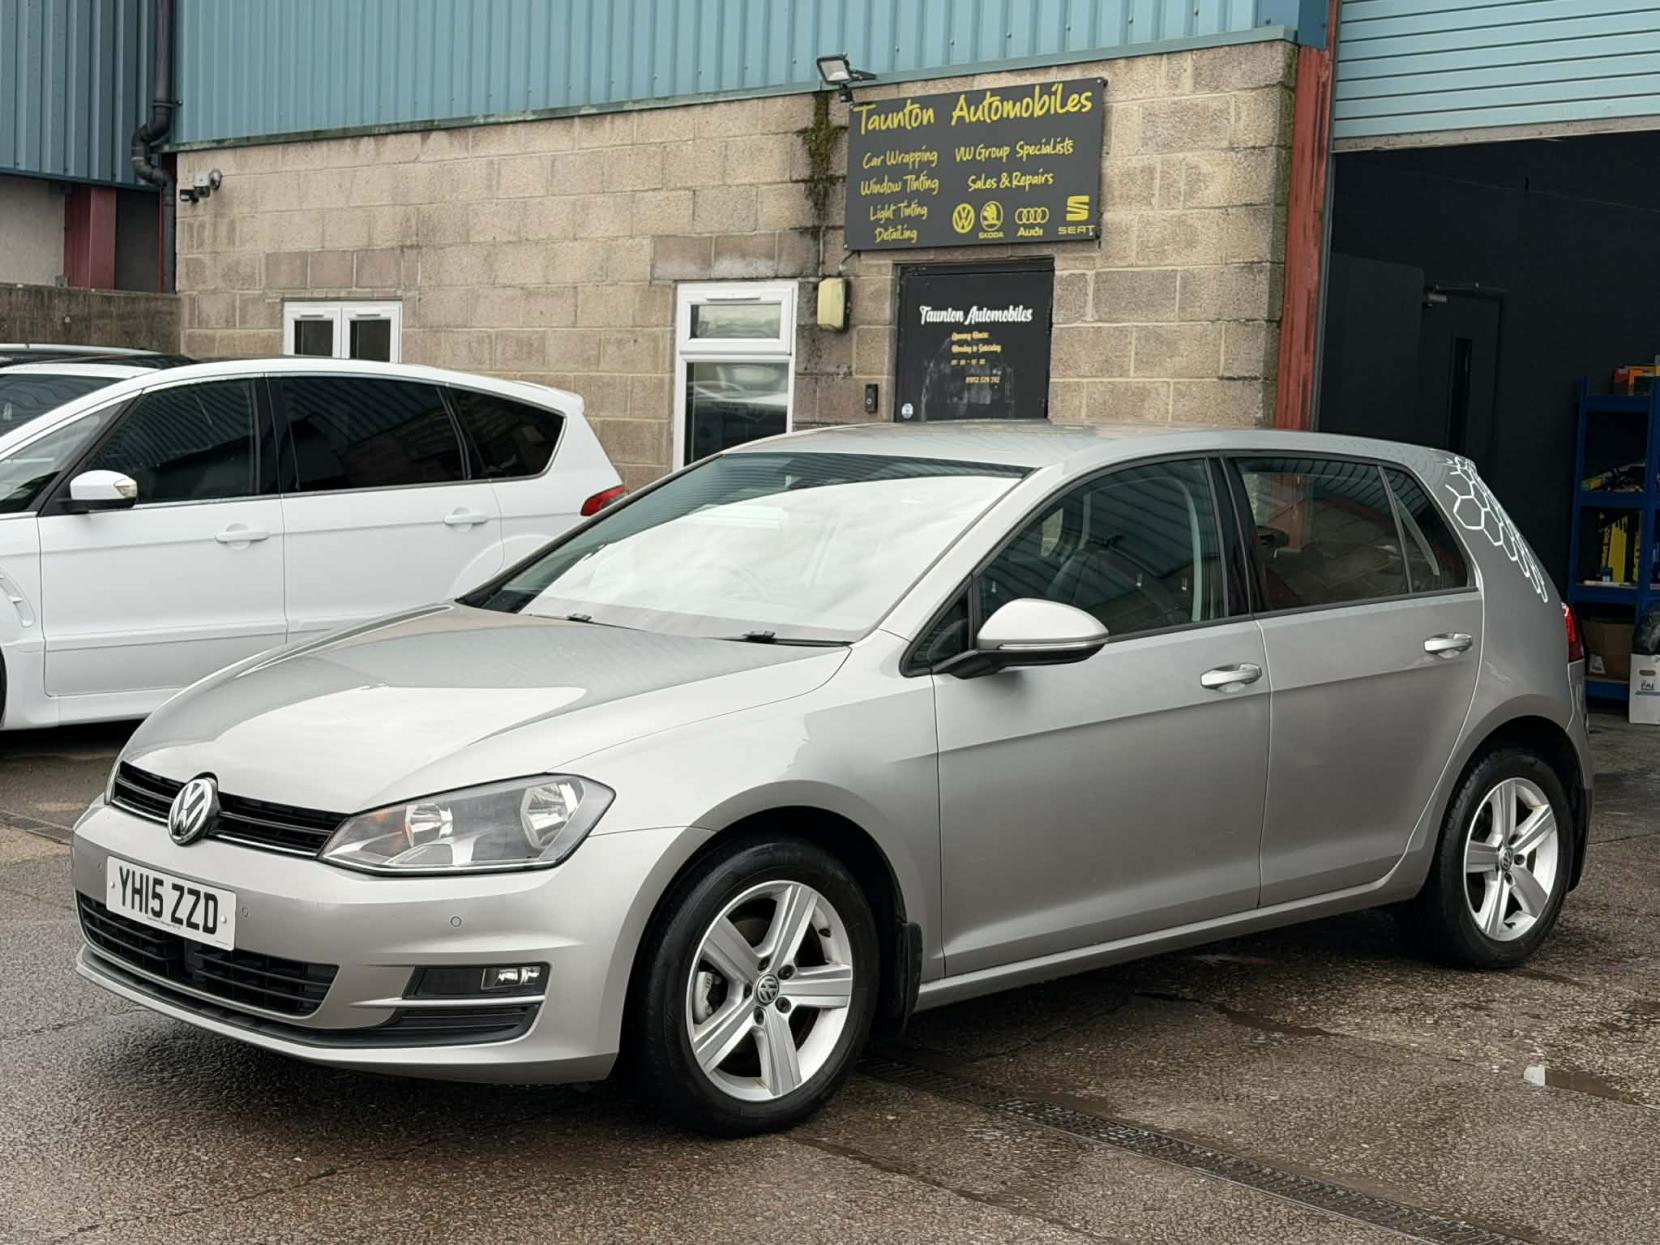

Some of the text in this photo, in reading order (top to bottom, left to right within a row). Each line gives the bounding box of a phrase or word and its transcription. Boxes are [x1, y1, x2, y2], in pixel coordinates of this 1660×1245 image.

[853, 82, 1093, 135] Taunton Automobiles
[862, 145, 938, 169] Car Wrapping
[975, 144, 1010, 162] Group
[1016, 137, 1074, 162] Specialists
[860, 170, 939, 196] Window Tinting
[968, 168, 1054, 192] Sales & Repairs
[869, 199, 928, 224] Light Tinting
[874, 224, 918, 243] Detailing
[1017, 226, 1044, 237] Audi
[1058, 225, 1096, 235] SEAT
[919, 305, 1033, 325] Taunton Automobiles
[119, 865, 219, 935] YH15 ZZD
